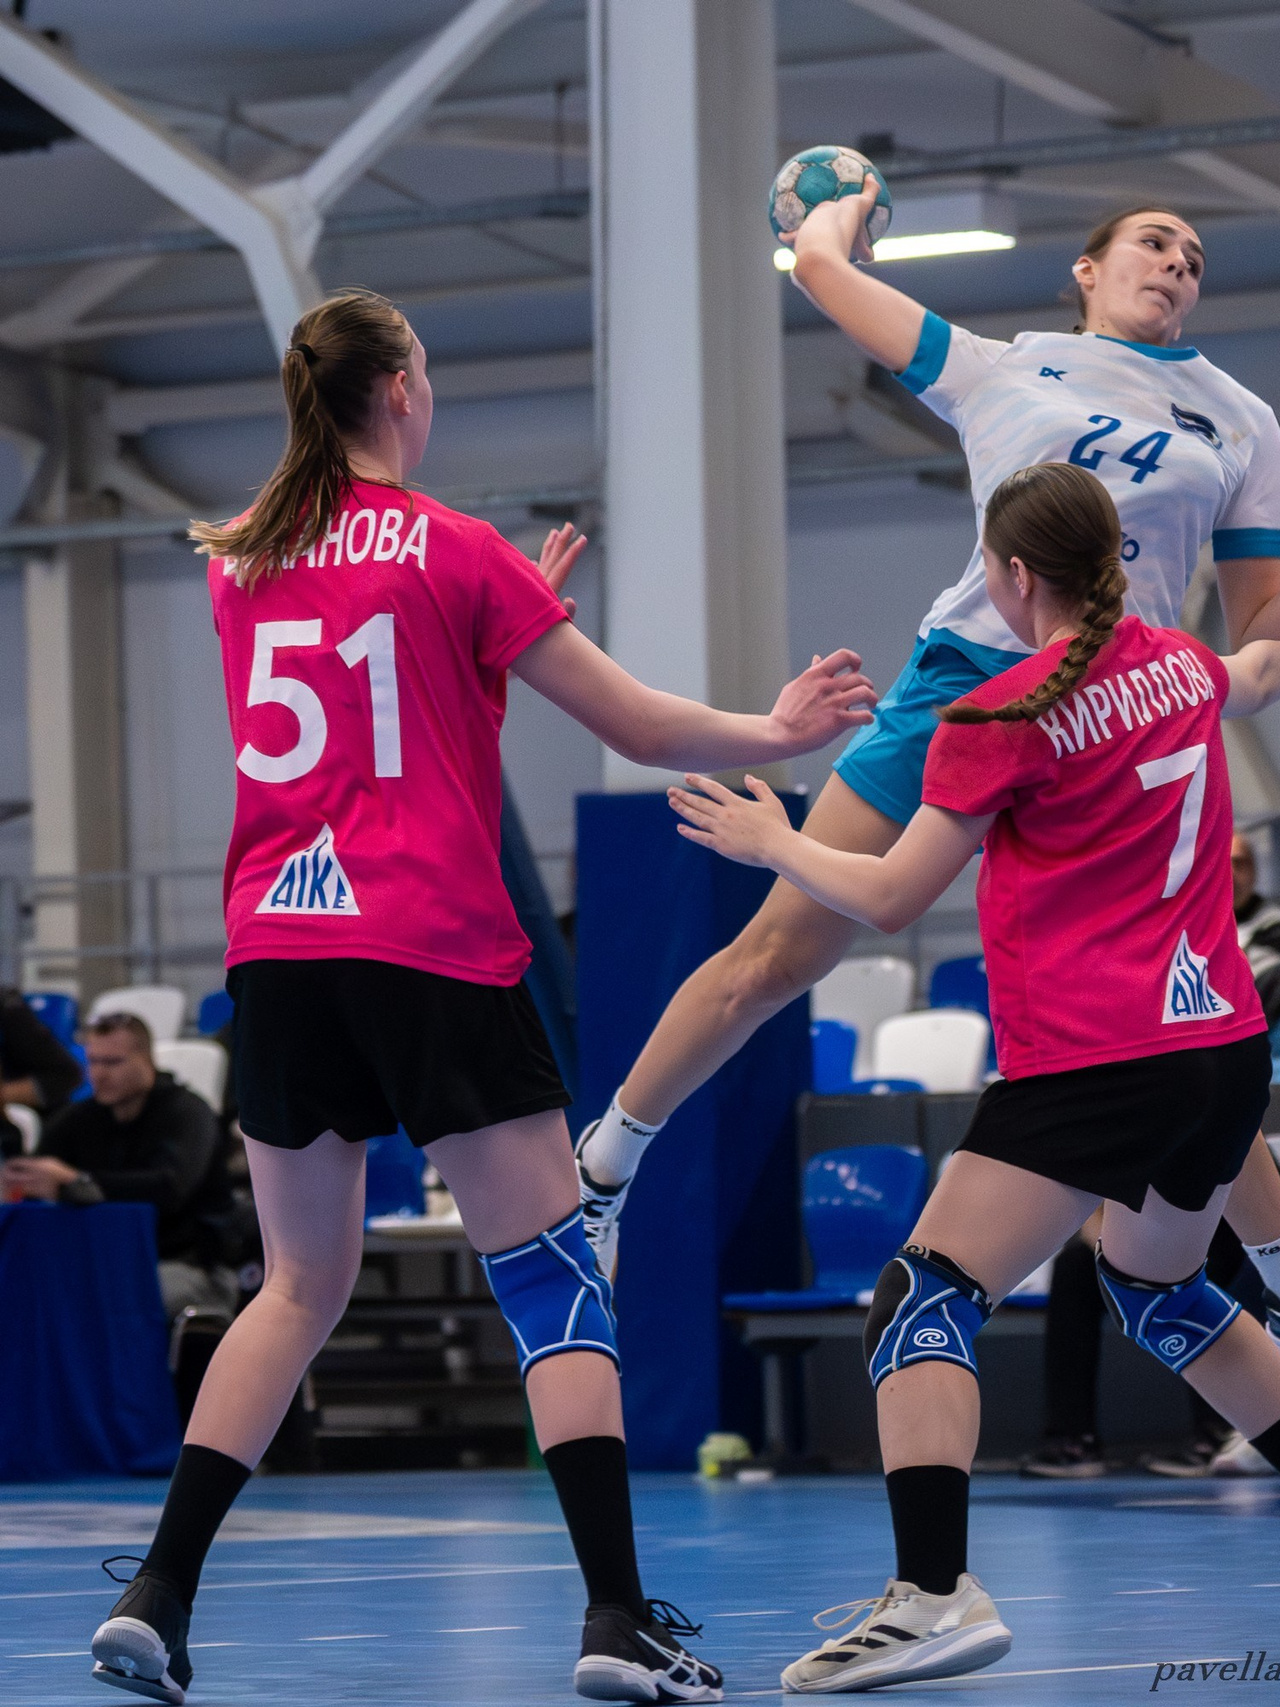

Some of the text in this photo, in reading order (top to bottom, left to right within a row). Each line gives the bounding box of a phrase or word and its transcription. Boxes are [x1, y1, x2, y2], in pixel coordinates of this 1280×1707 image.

[1067, 414, 1174, 485] 24
[222, 507, 430, 588] АНОВА
[236, 612, 403, 784] 51
[1134, 742, 1208, 899] 7
